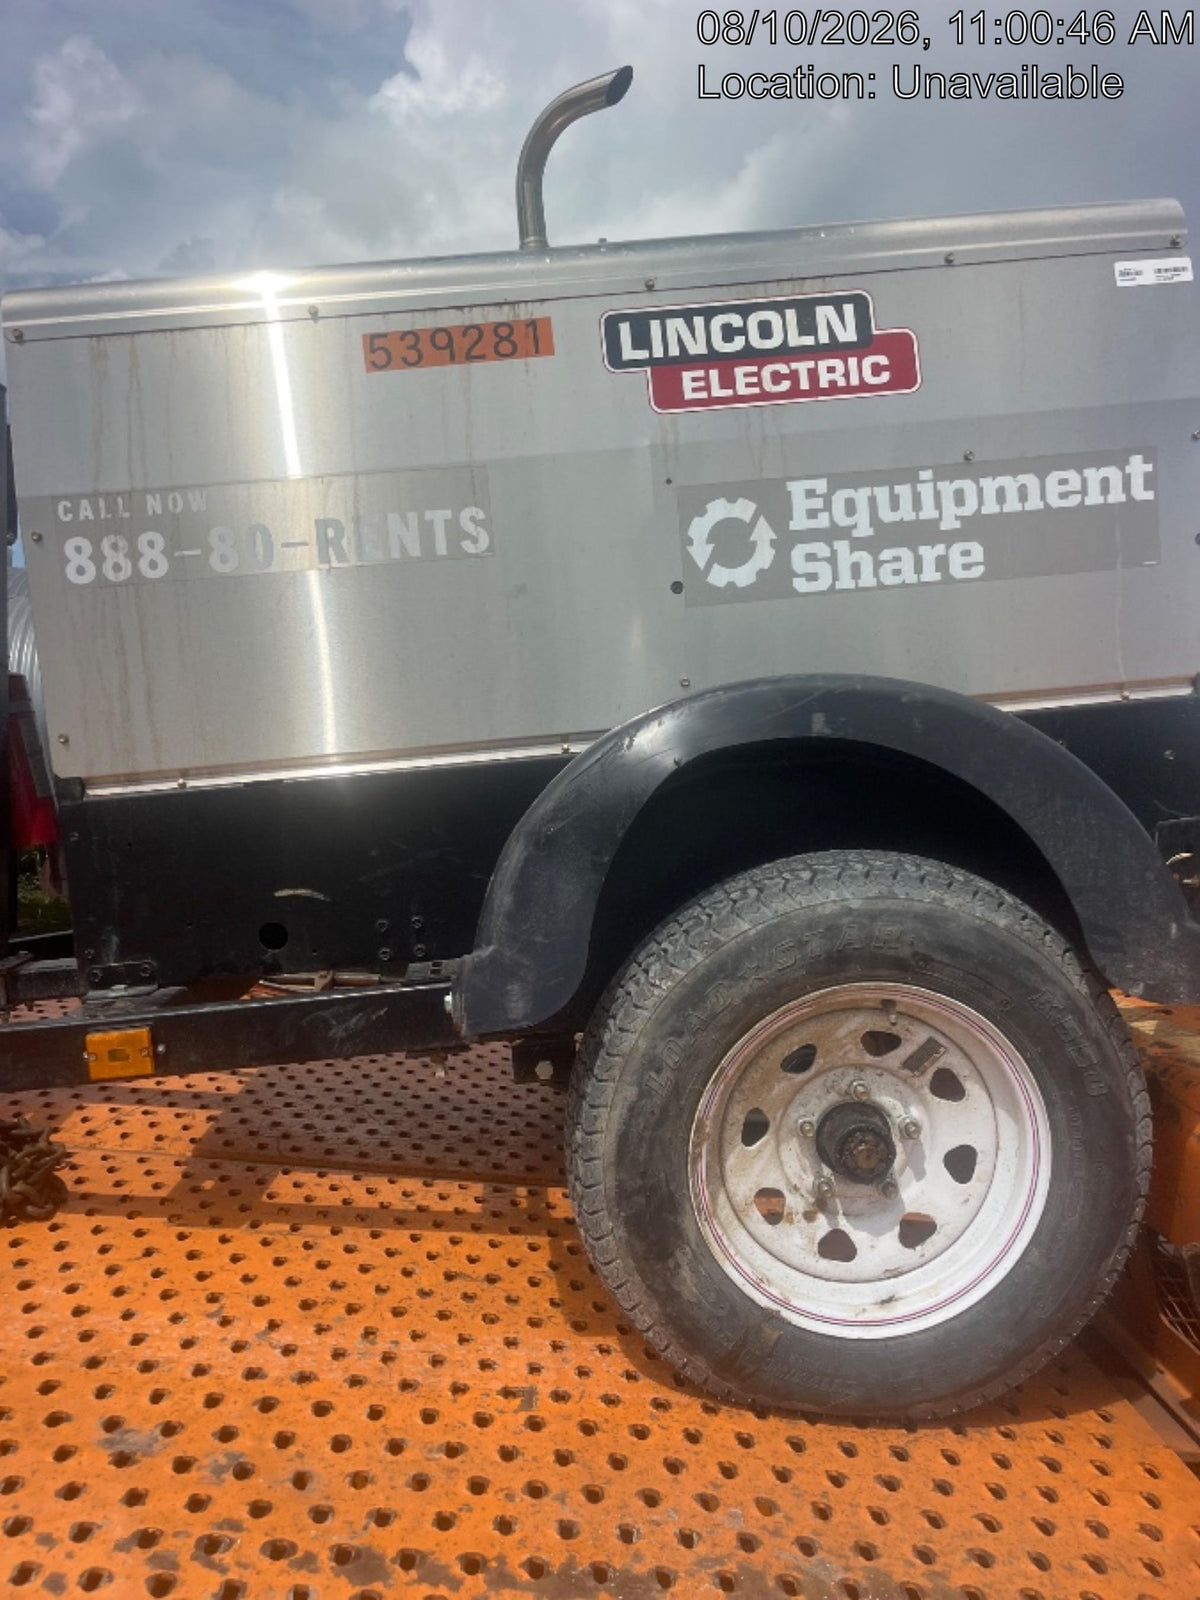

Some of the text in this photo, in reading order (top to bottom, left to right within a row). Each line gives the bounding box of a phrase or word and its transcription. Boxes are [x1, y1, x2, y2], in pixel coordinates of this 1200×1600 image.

[368, 319, 541, 370] 539281
[619, 303, 858, 361] LINCOLN
[681, 355, 891, 400] ELECTRIC
[57, 490, 208, 522] CALL NOW
[786, 454, 1155, 538] Equipment
[64, 505, 490, 585] 888-80-RENTS
[790, 540, 986, 593] Share
